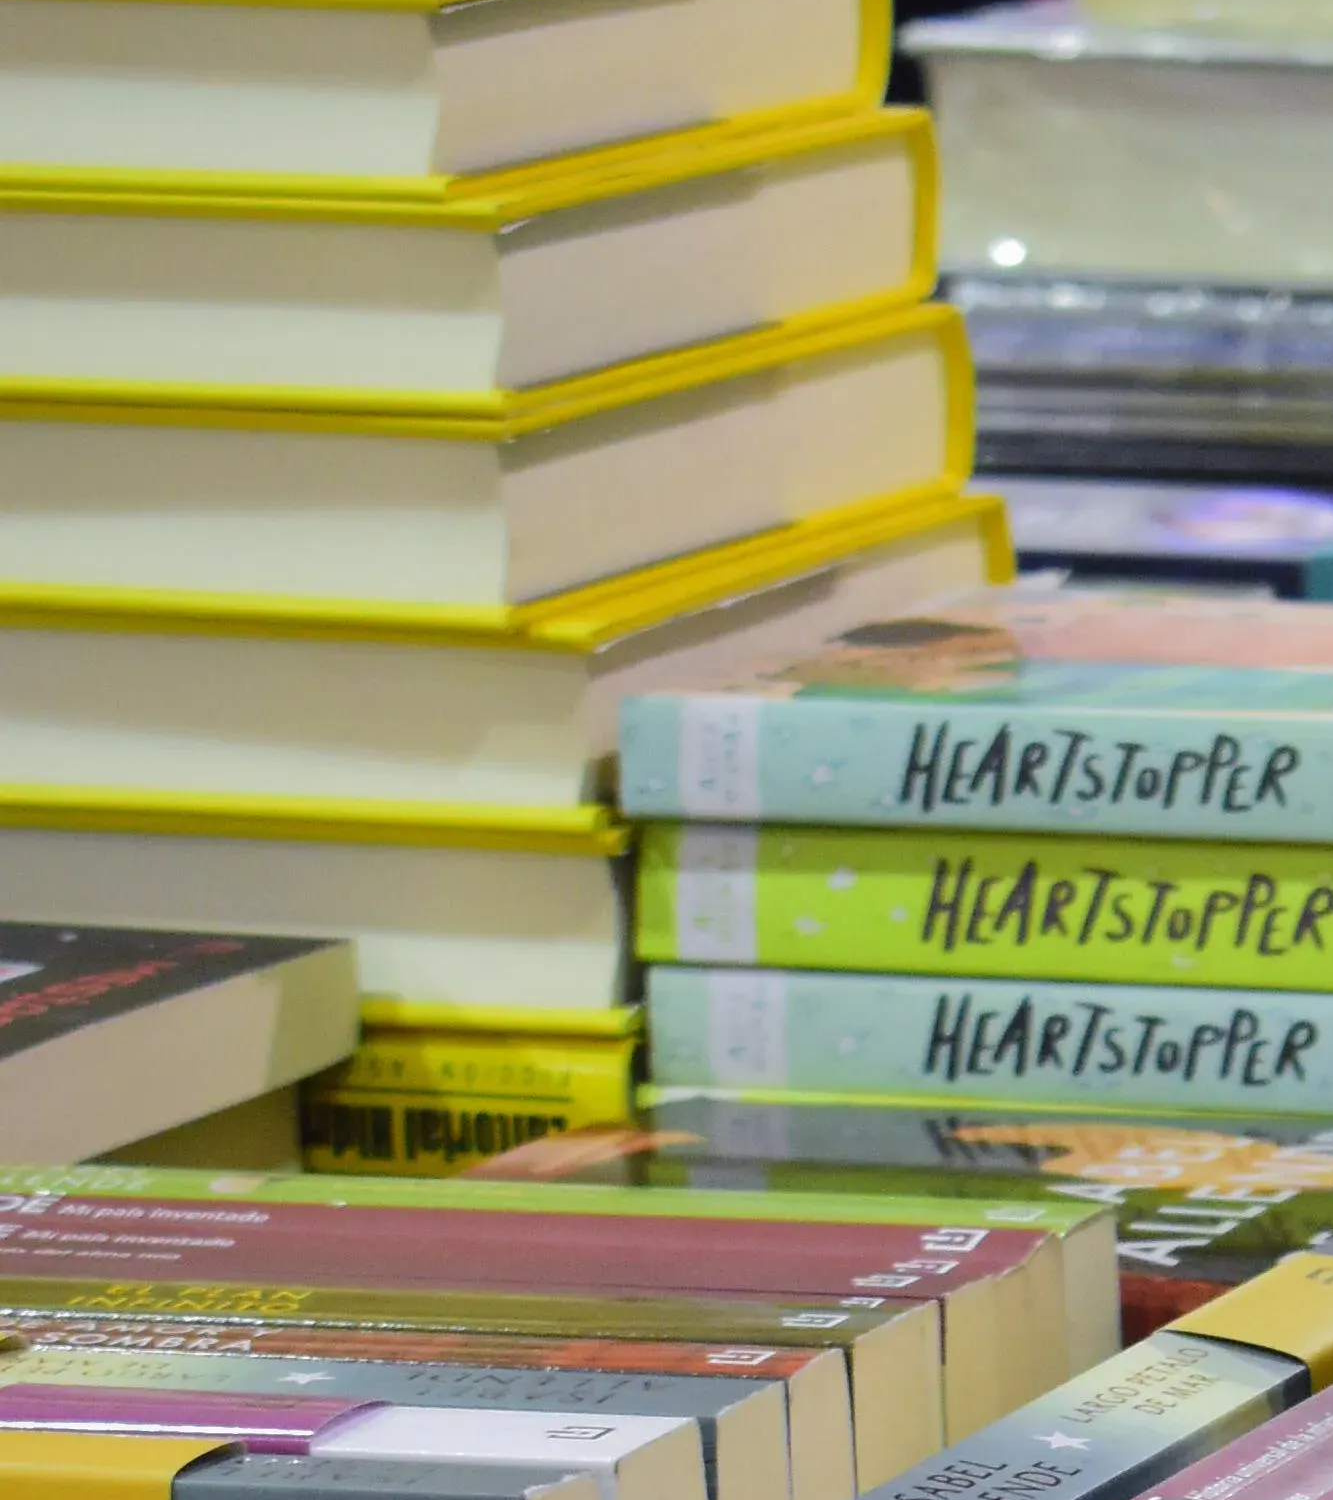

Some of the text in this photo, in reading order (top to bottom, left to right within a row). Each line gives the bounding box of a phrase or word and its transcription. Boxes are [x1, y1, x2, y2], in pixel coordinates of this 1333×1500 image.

[901, 721, 1301, 813] HEARTSTOPPER
[924, 994, 1319, 1087] HEARTSTOPPER
[149, 1207, 270, 1225] inventado
[35, 1332, 253, 1350] SOMBRA
